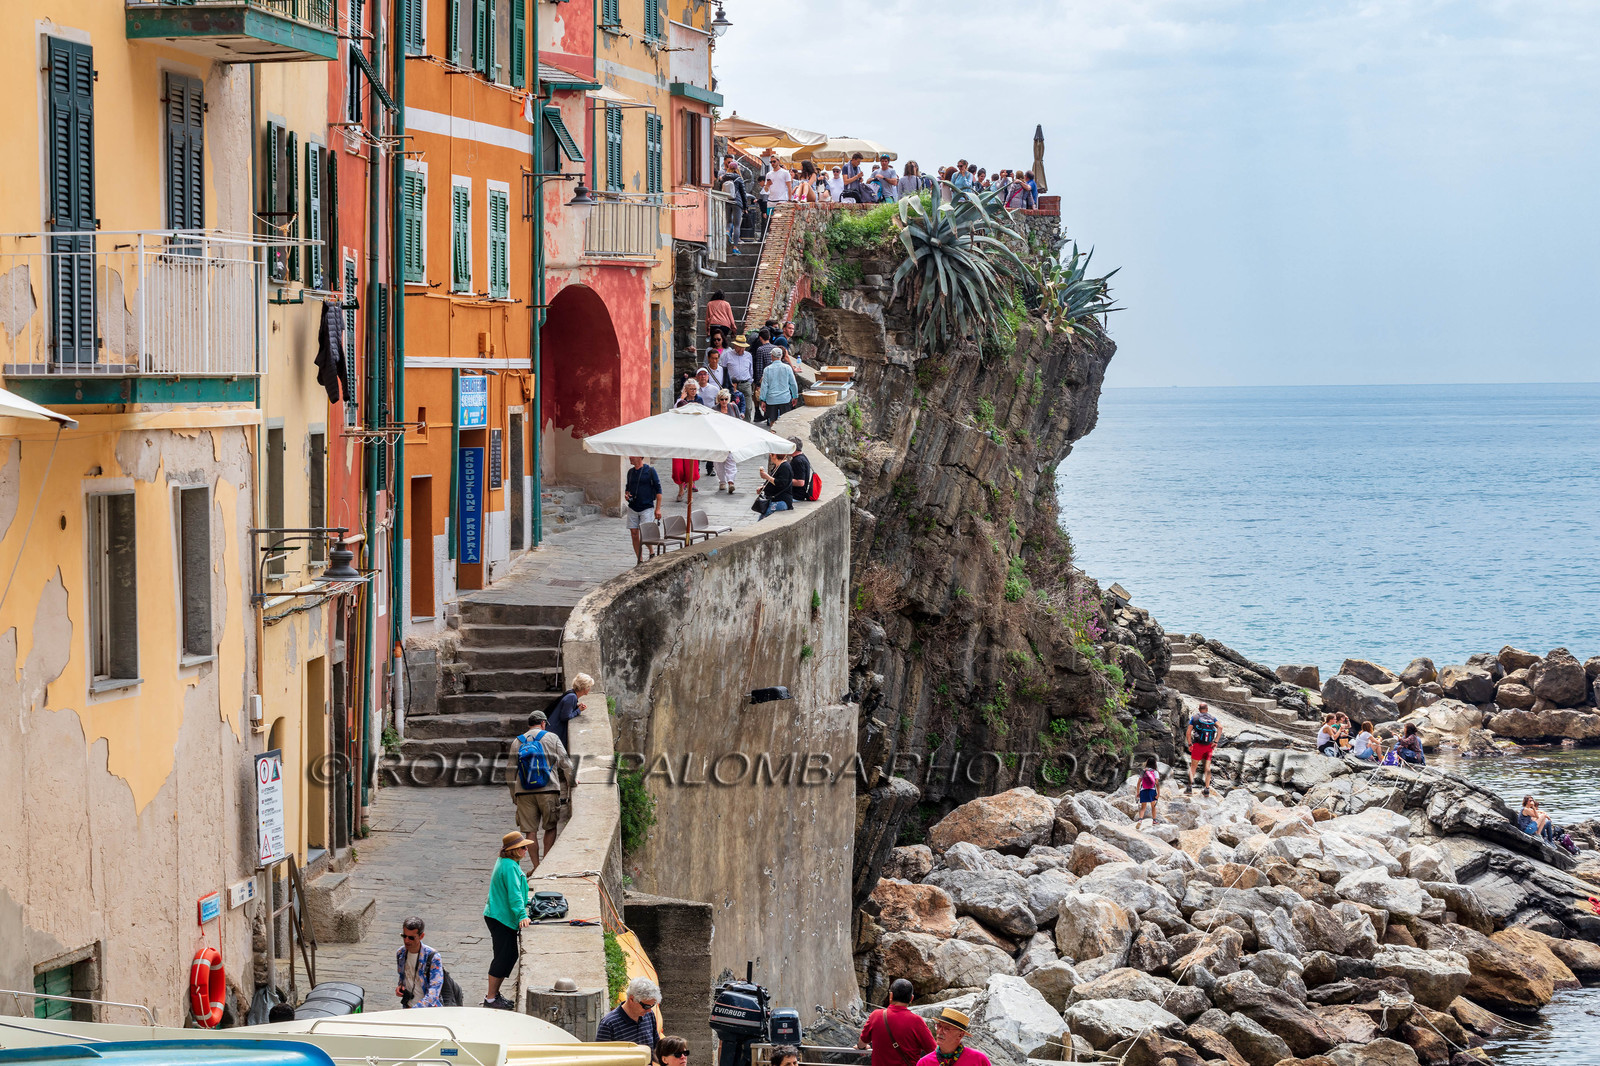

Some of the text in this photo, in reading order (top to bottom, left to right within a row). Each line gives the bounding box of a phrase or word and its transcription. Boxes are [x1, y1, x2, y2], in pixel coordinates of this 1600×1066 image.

[465, 451, 478, 562] PRODUZIONE PROPRIA
[714, 1006, 746, 1018] EVINRUDE
